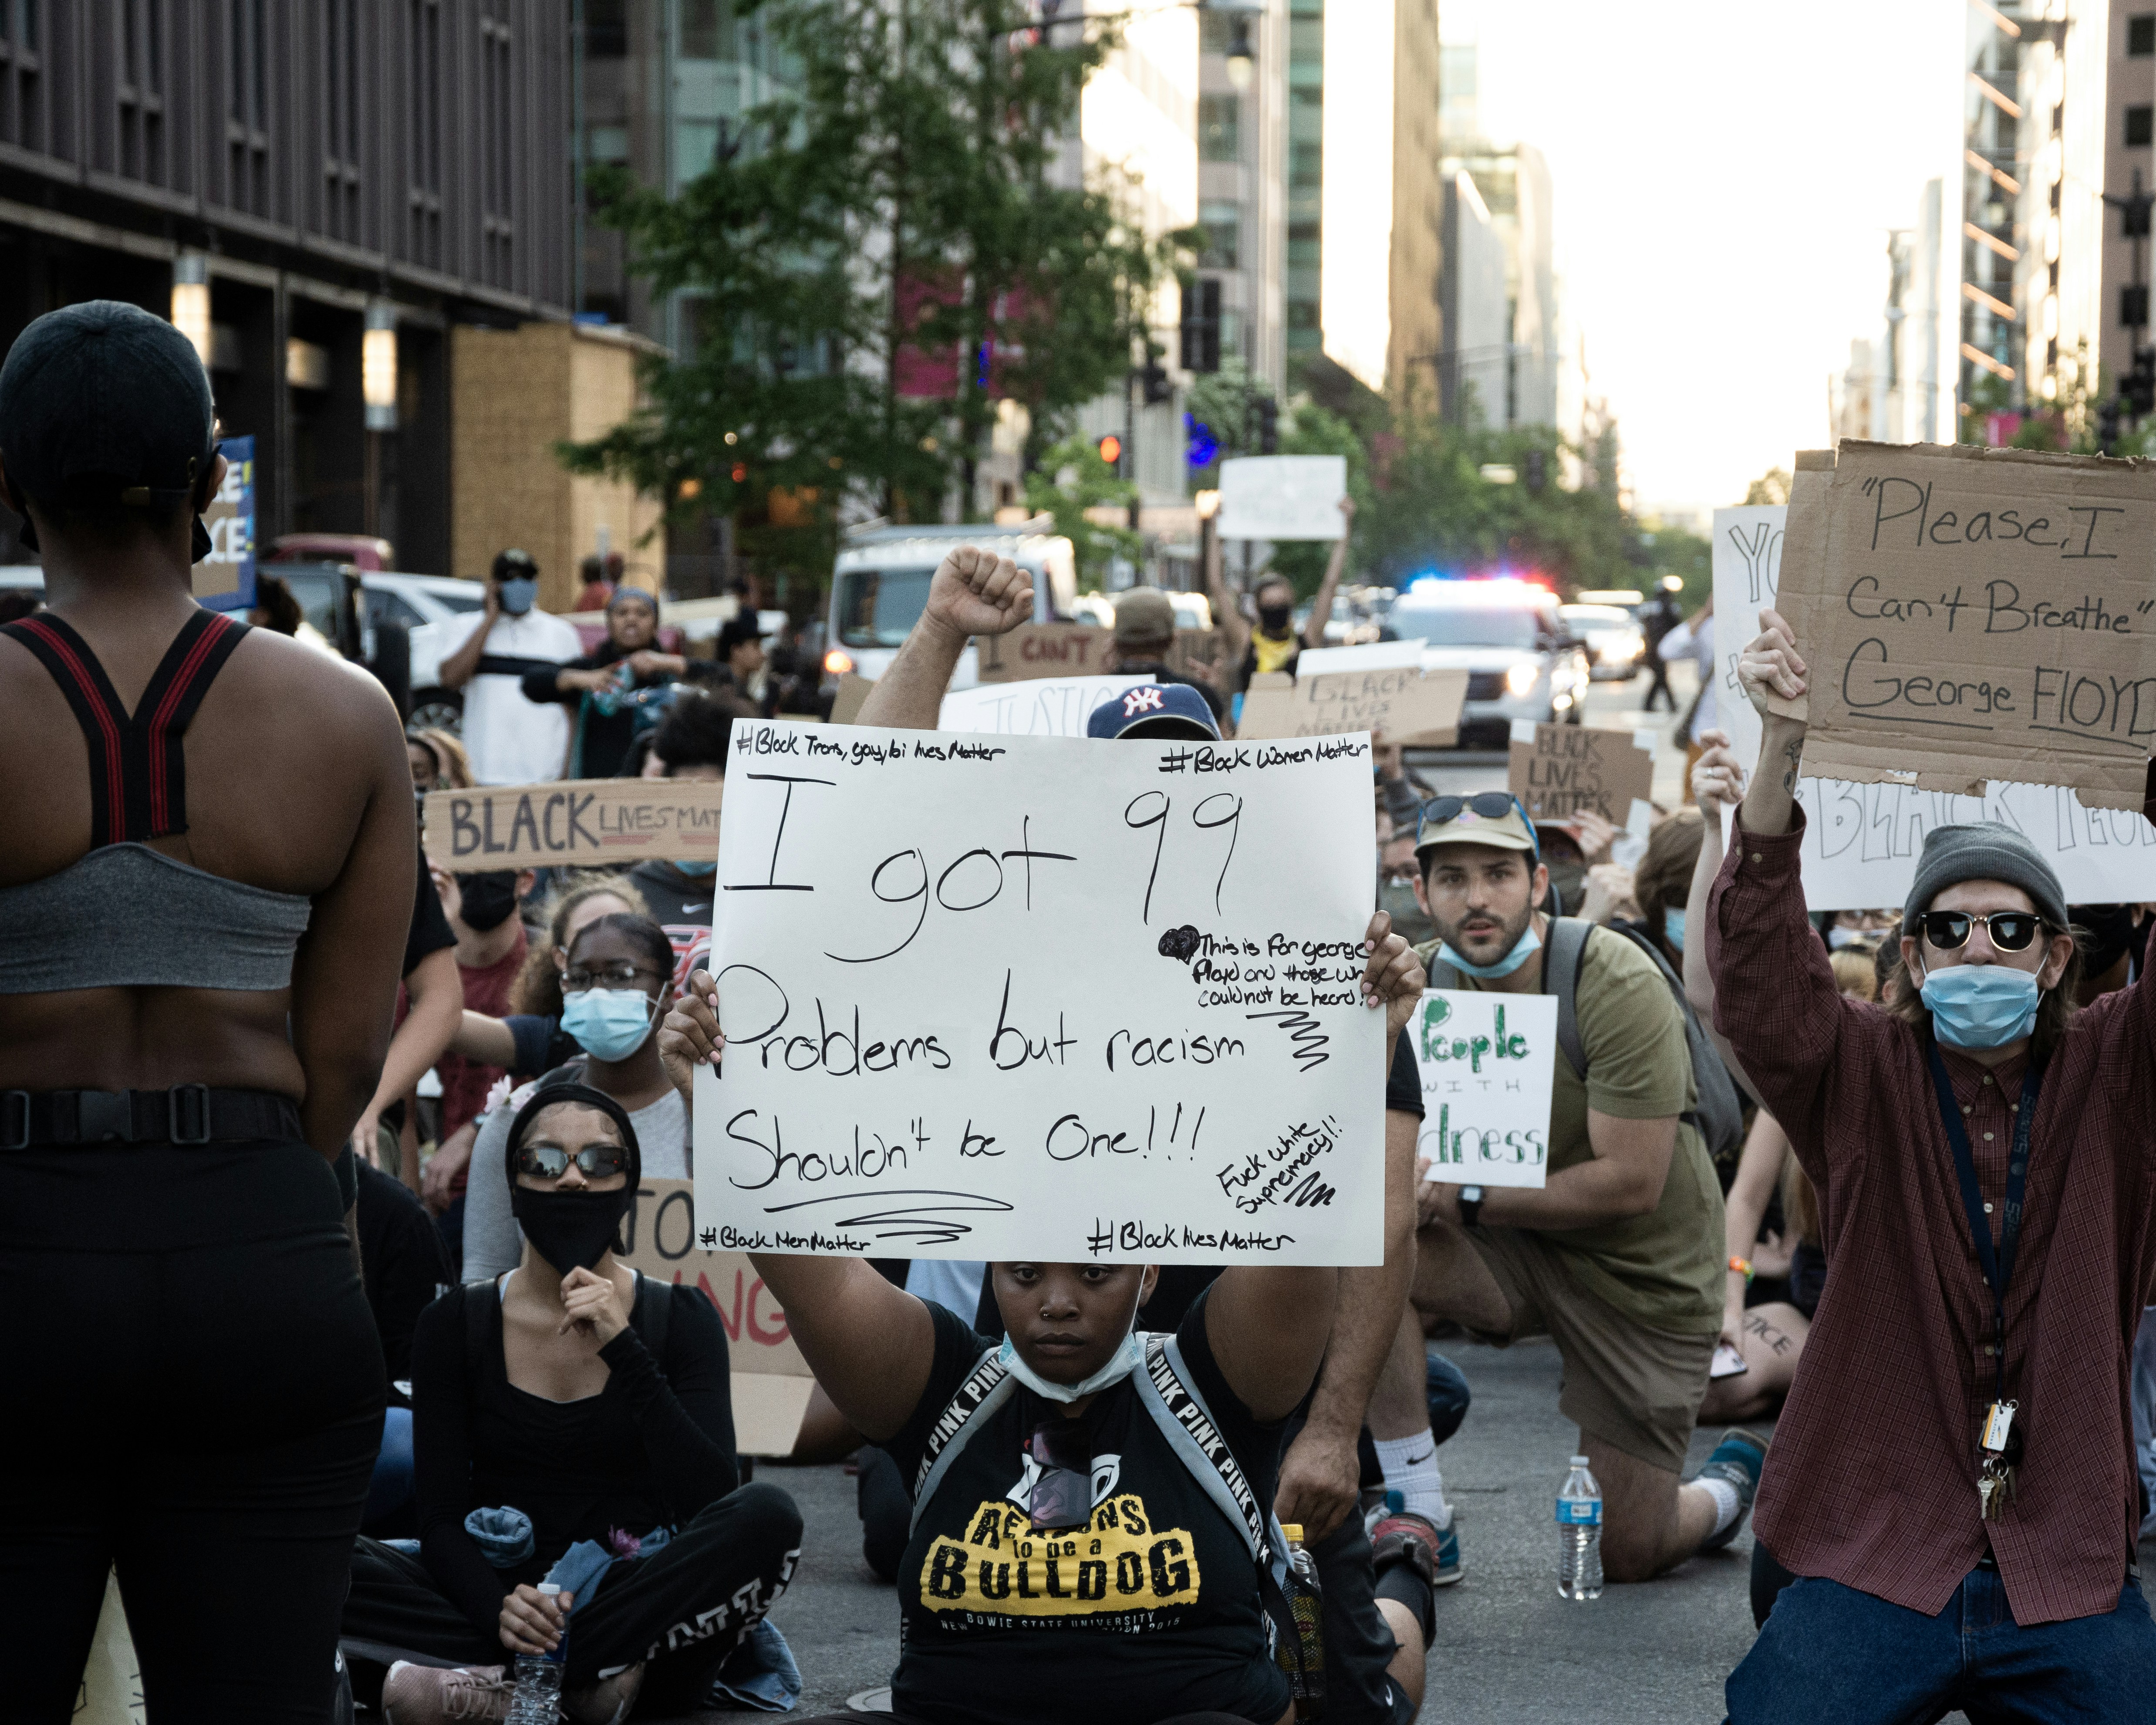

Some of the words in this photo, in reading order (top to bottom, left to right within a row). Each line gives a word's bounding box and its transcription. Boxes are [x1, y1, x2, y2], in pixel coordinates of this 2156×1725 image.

[2061, 506, 2125, 559] I
[1847, 576, 1968, 631] Can't
[1843, 638, 2015, 713] George
[948, 739, 1006, 761] Matter
[1257, 745, 1312, 769] Women
[1316, 735, 1369, 763] Matter
[450, 792, 600, 856] BLACK
[598, 803, 675, 833] LIVES
[723, 773, 837, 891] I
[823, 814, 1078, 963] got
[1200, 933, 1239, 957] This
[1243, 938, 1260, 957] is
[1244, 963, 1276, 982] and
[1282, 963, 1335, 985] those
[1280, 986, 1309, 1006] be
[713, 964, 951, 1080] Problems
[989, 968, 1078, 1071] but
[1106, 1028, 1245, 1072] racism
[1420, 992, 1530, 1074] People
[725, 1109, 931, 1190] Shouldn't
[960, 1118, 1006, 1157] be
[1046, 1102, 1205, 1161] One!!!
[1215, 1154, 1267, 1197] Fuck
[699, 1225, 773, 1249] #Black
[776, 1232, 810, 1250] Men
[811, 1231, 870, 1252] Matter
[1220, 1230, 1296, 1251] Matter
[964, 1355, 1007, 1403] PINK
[1147, 1353, 1185, 1406] PINK
[928, 1399, 972, 1455] PINK
[1176, 1402, 1224, 1460] PINK
[1218, 1457, 1252, 1513] PINK
[928, 1537, 1192, 1601] BULLDOG
[966, 1613, 1013, 1630] BOWIE
[1071, 1611, 1155, 1630] UNIVERSITY
